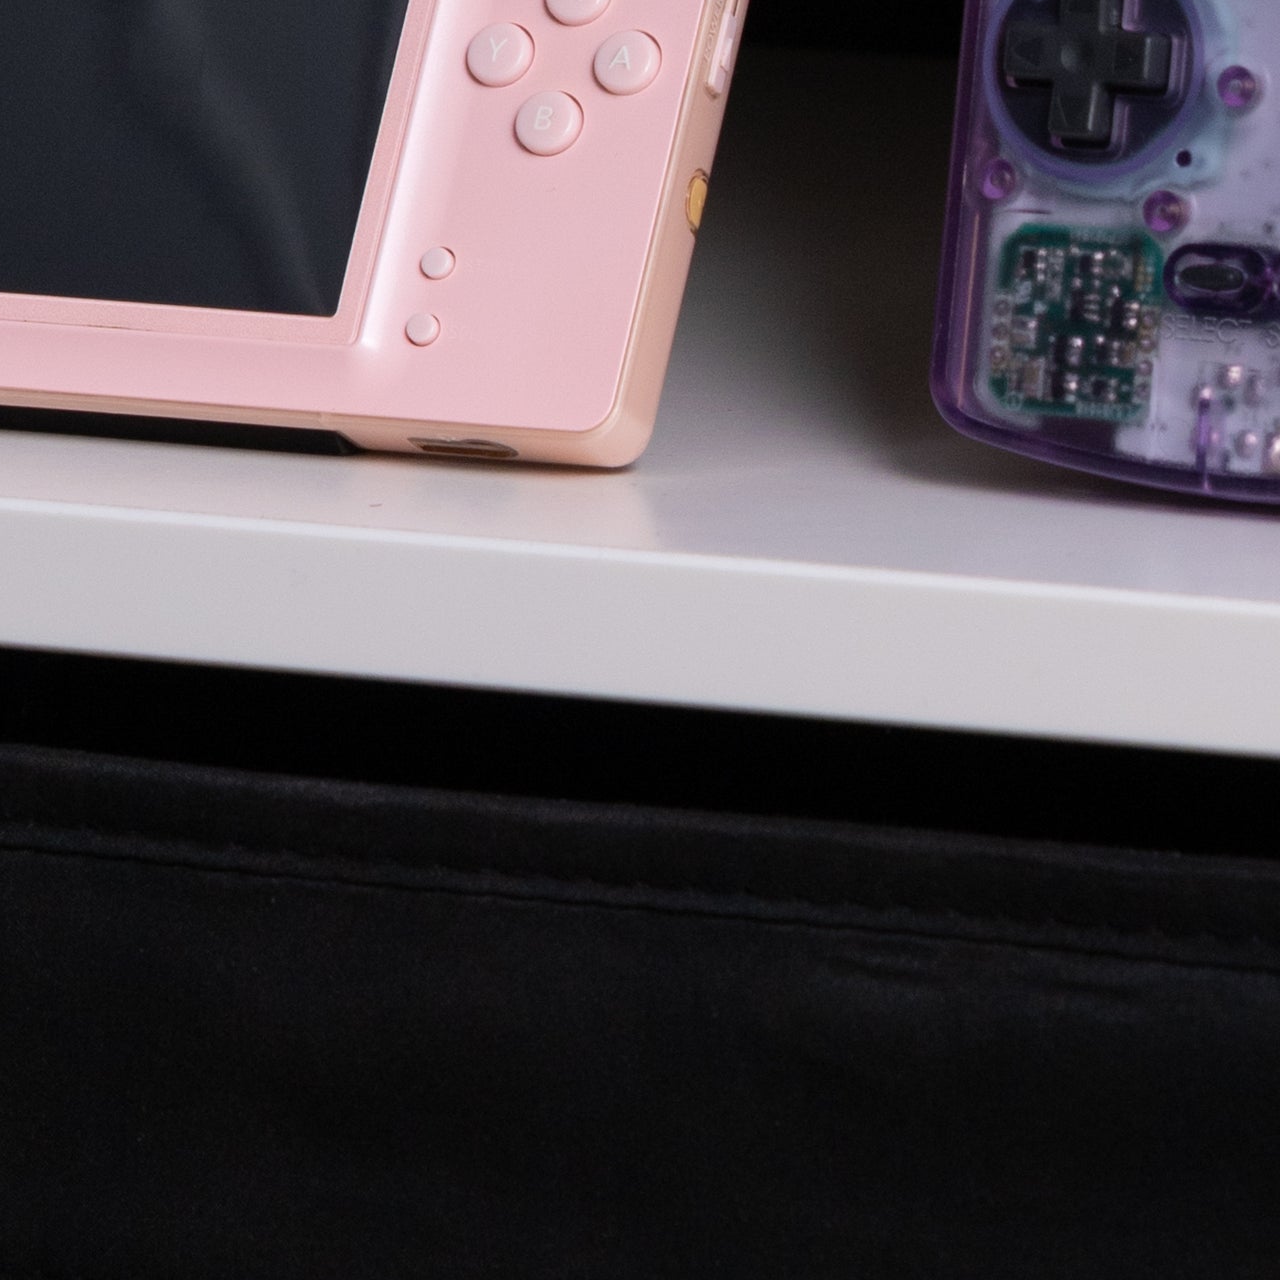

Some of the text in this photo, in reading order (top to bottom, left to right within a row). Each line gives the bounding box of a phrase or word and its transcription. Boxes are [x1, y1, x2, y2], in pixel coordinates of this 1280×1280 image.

[488, 37, 508, 63] Y
[608, 44, 632, 72] A
[533, 105, 555, 131] B
